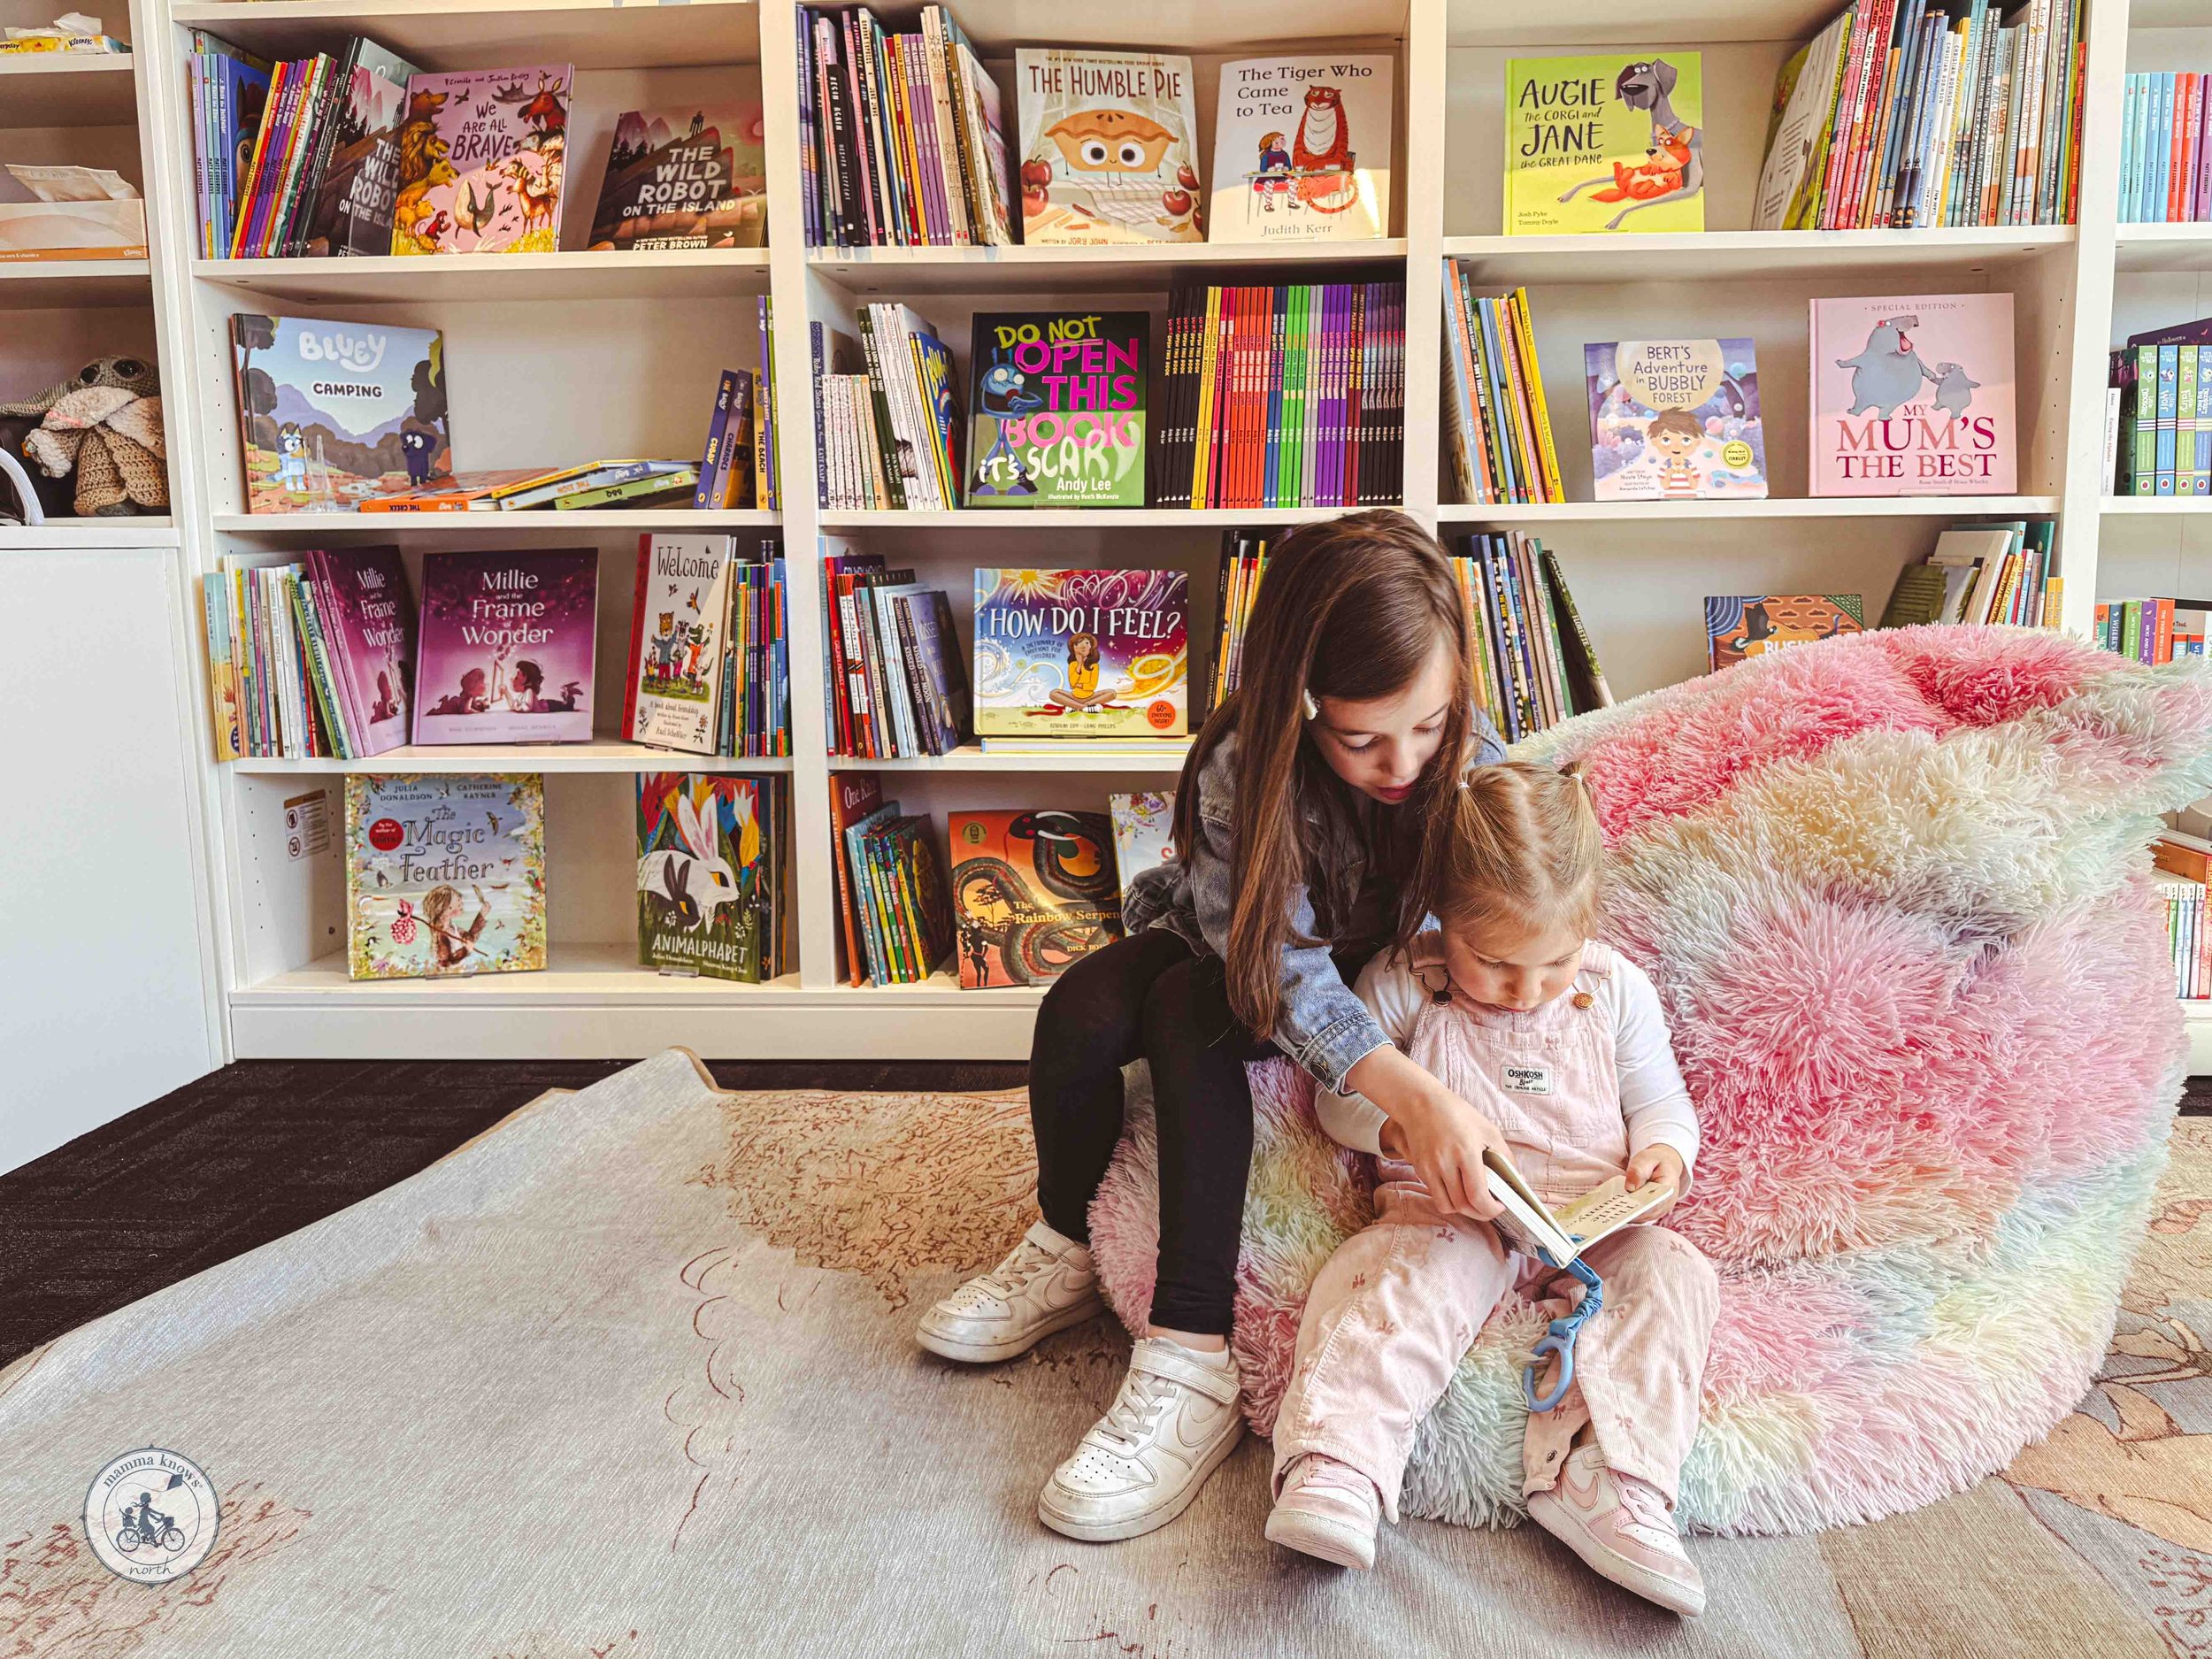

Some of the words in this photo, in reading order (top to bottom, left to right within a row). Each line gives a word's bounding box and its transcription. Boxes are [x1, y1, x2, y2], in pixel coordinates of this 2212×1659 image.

[69, 37, 92, 48] Kleenex
[1942, 42, 1951, 72] CHRISTIAN
[1949, 44, 1959, 74] CHRISTIAN
[1029, 65, 1063, 93] THE
[1071, 65, 1146, 98] HUMBLE
[1154, 68, 1181, 100] PIE
[1239, 68, 1272, 81] The
[1278, 66, 1325, 81] Tiger
[1330, 65, 1372, 77] Who
[828, 75, 839, 100] BEGIN
[1238, 87, 1288, 99] Came
[1519, 79, 1605, 109] AUGIE
[1938, 74, 1947, 104] ROBINSON
[1946, 77, 1955, 106] ROBINSON
[476, 102, 496, 119] We
[832, 106, 843, 131] AGAIN
[1237, 106, 1253, 118] to
[1259, 104, 1293, 115] Tea
[1525, 112, 1540, 122] the
[1545, 110, 1579, 121] CORGI
[1582, 106, 1601, 119] and
[489, 119, 507, 133] ALL
[375, 138, 401, 162] THE
[452, 134, 513, 161] BRAVE
[1521, 121, 1603, 157] JANE
[669, 146, 713, 162] THE
[1521, 159, 1536, 169] the
[1540, 157, 1570, 167] GREAT
[657, 161, 721, 182] WILD
[1974, 160, 1983, 196] PIGNATARO
[349, 175, 396, 212] ROBO
[638, 180, 726, 204] ROBOT
[339, 200, 351, 214] ON
[353, 206, 372, 221] THE
[373, 211, 393, 227] ISLA
[623, 205, 641, 217] ON
[647, 203, 677, 214] THE
[682, 200, 735, 213] ISLAND
[1261, 224, 1300, 237] Judith
[1307, 225, 1333, 234] Kerr
[634, 241, 666, 250] PETER
[669, 240, 708, 250] BROWN
[995, 324, 1041, 349] DO
[1048, 316, 1102, 343] NOT
[1015, 338, 1139, 374] OPEN
[1647, 346, 1691, 359] BERT'S
[810, 357, 822, 374] Ruby
[1634, 361, 1708, 374] Adventure
[313, 383, 382, 397] CAMPING
[813, 375, 822, 388] Red
[1042, 375, 1138, 411] THIS
[1648, 375, 1706, 391] BUBBLY
[813, 388, 825, 409] Shoes
[1653, 392, 1692, 403] FOREST
[2139, 387, 2149, 417] Dinosaur
[2159, 389, 2170, 412] Wolf
[2178, 388, 2190, 412] Fairy
[1904, 404, 1929, 417] MY
[1000, 411, 1136, 449] BOOK
[1836, 417, 1995, 452] MUM'S
[707, 437, 718, 465] CUBBY
[720, 432, 734, 472] CHARADES
[816, 447, 826, 463] KATE
[1025, 421, 1141, 482] SCARY
[817, 464, 827, 482] KNAPP
[1836, 455, 1905, 479] THE
[1916, 454, 1997, 478] BEST
[604, 488, 622, 497] BBQ
[1056, 477, 1087, 492] Andy
[1092, 478, 1111, 490] Lee
[657, 546, 719, 580] Welcome
[357, 567, 386, 590] Millie
[482, 569, 539, 590] Millie
[360, 600, 396, 619] Frame
[472, 599, 545, 618] Frame
[462, 623, 554, 645] Wonder
[990, 608, 1045, 638] HOW
[1051, 607, 1085, 635] DO
[1093, 607, 1099, 634] I
[1109, 608, 1181, 639] FEEL?
[1571, 613, 1590, 648] FLORETTE
[363, 622, 404, 648] Wonder
[904, 645, 915, 671] KISSED
[911, 682, 922, 704] MOON
[911, 644, 923, 670] KISSED
[920, 680, 931, 703] MOON
[380, 793, 433, 802] DONALDSON
[432, 805, 457, 820] The
[402, 816, 485, 854] Magic
[399, 846, 494, 883] Feather
[1014, 901, 1033, 910] The
[1016, 909, 1072, 924] Rainbow
[1076, 909, 1122, 923] Serpen
[652, 933, 748, 964] ANIMALPHABET
[1592, 1201, 1629, 1222] little
[1601, 1202, 1639, 1225] This
